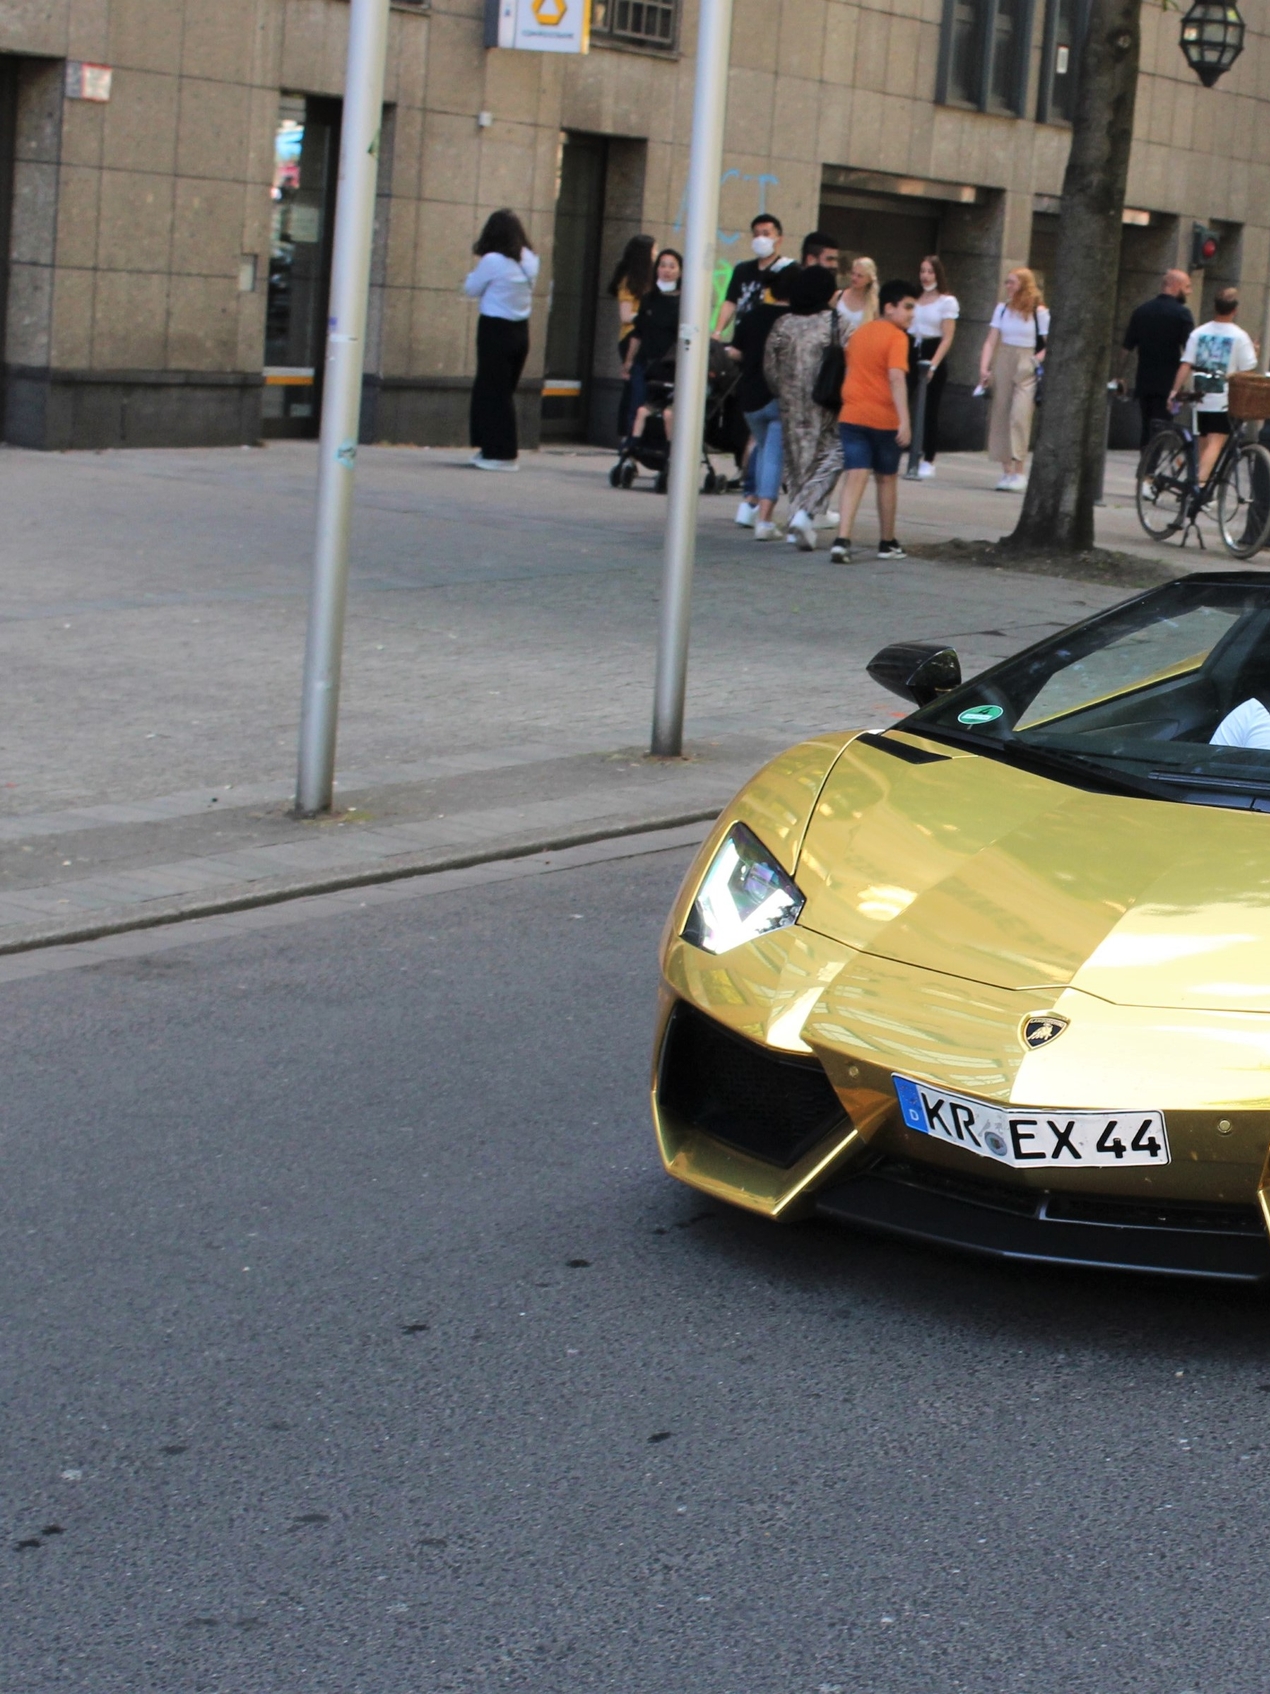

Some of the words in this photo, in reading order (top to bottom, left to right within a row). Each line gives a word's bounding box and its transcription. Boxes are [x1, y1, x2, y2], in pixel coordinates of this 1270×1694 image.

[921, 1092, 983, 1148] KR
[1009, 1119, 1082, 1159] EX
[1096, 1119, 1162, 1159] 44
